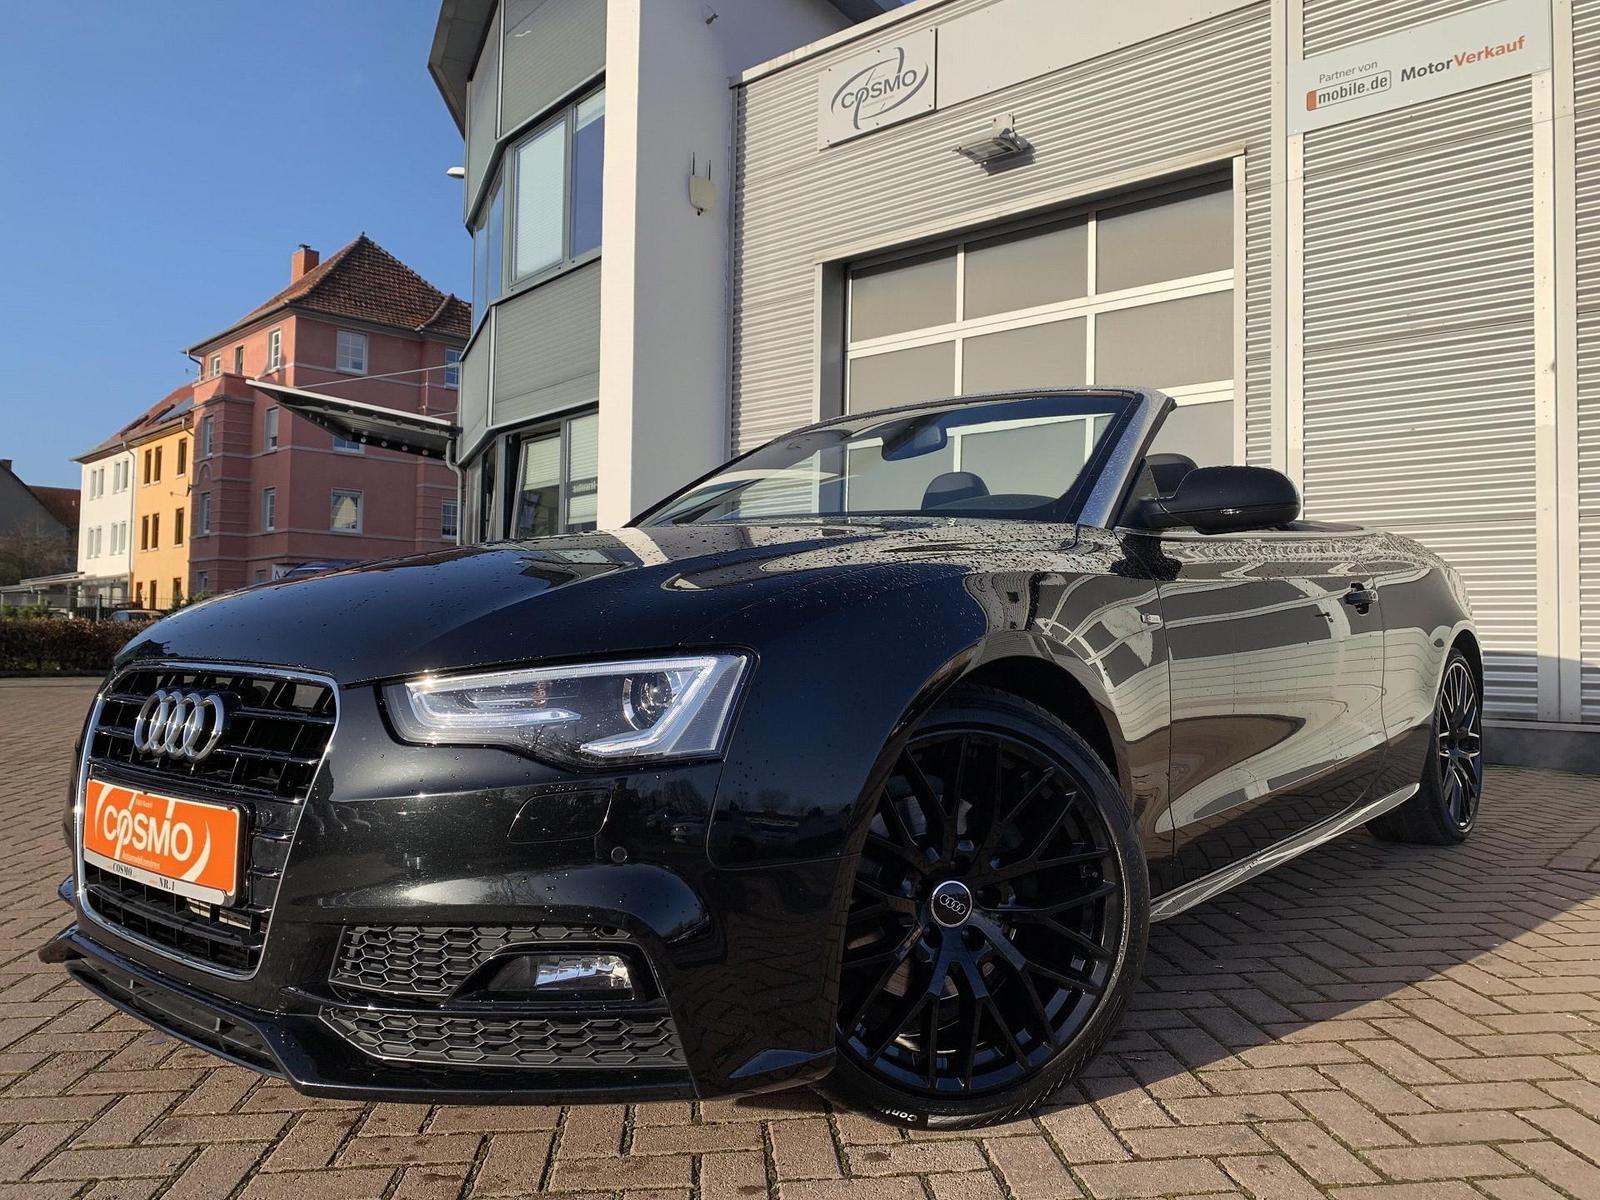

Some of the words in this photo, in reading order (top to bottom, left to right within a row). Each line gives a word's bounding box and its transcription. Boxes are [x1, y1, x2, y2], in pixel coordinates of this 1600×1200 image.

[1319, 67, 1356, 84] Partner
[1357, 61, 1379, 73] von
[1400, 35, 1526, 82] MotorVerkauf
[841, 69, 917, 110] COSMO
[1318, 76, 1388, 105] mobile.de
[104, 804, 193, 862] COSMO
[112, 863, 133, 877] COSMO
